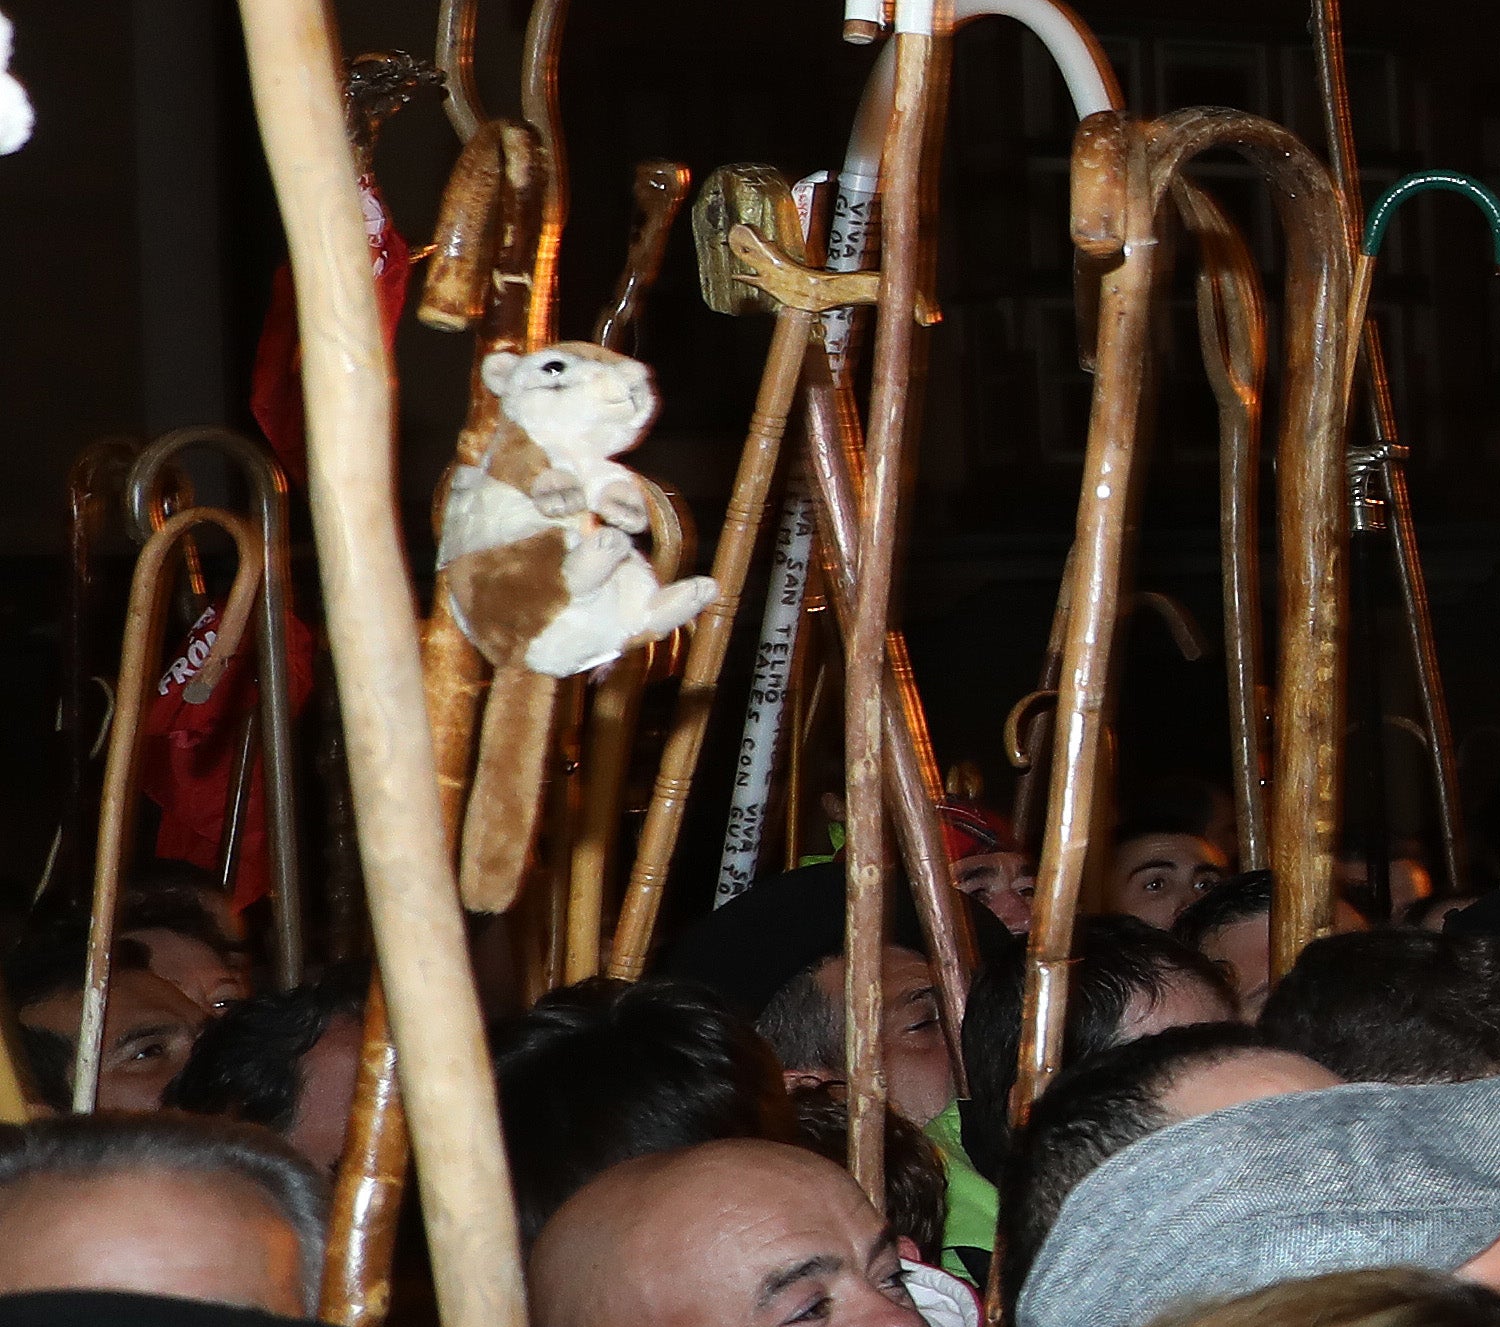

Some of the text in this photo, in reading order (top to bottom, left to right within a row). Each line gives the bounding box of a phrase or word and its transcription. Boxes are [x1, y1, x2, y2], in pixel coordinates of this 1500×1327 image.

[825, 193, 848, 273] GLORI
[842, 201, 869, 260] VIVA
[780, 557, 805, 607] SAN
[747, 641, 773, 724] SALES
[764, 623, 792, 704] TELMO
[736, 735, 757, 787] CON
[717, 806, 745, 896] GUSTO
[737, 802, 761, 855] VIVA
